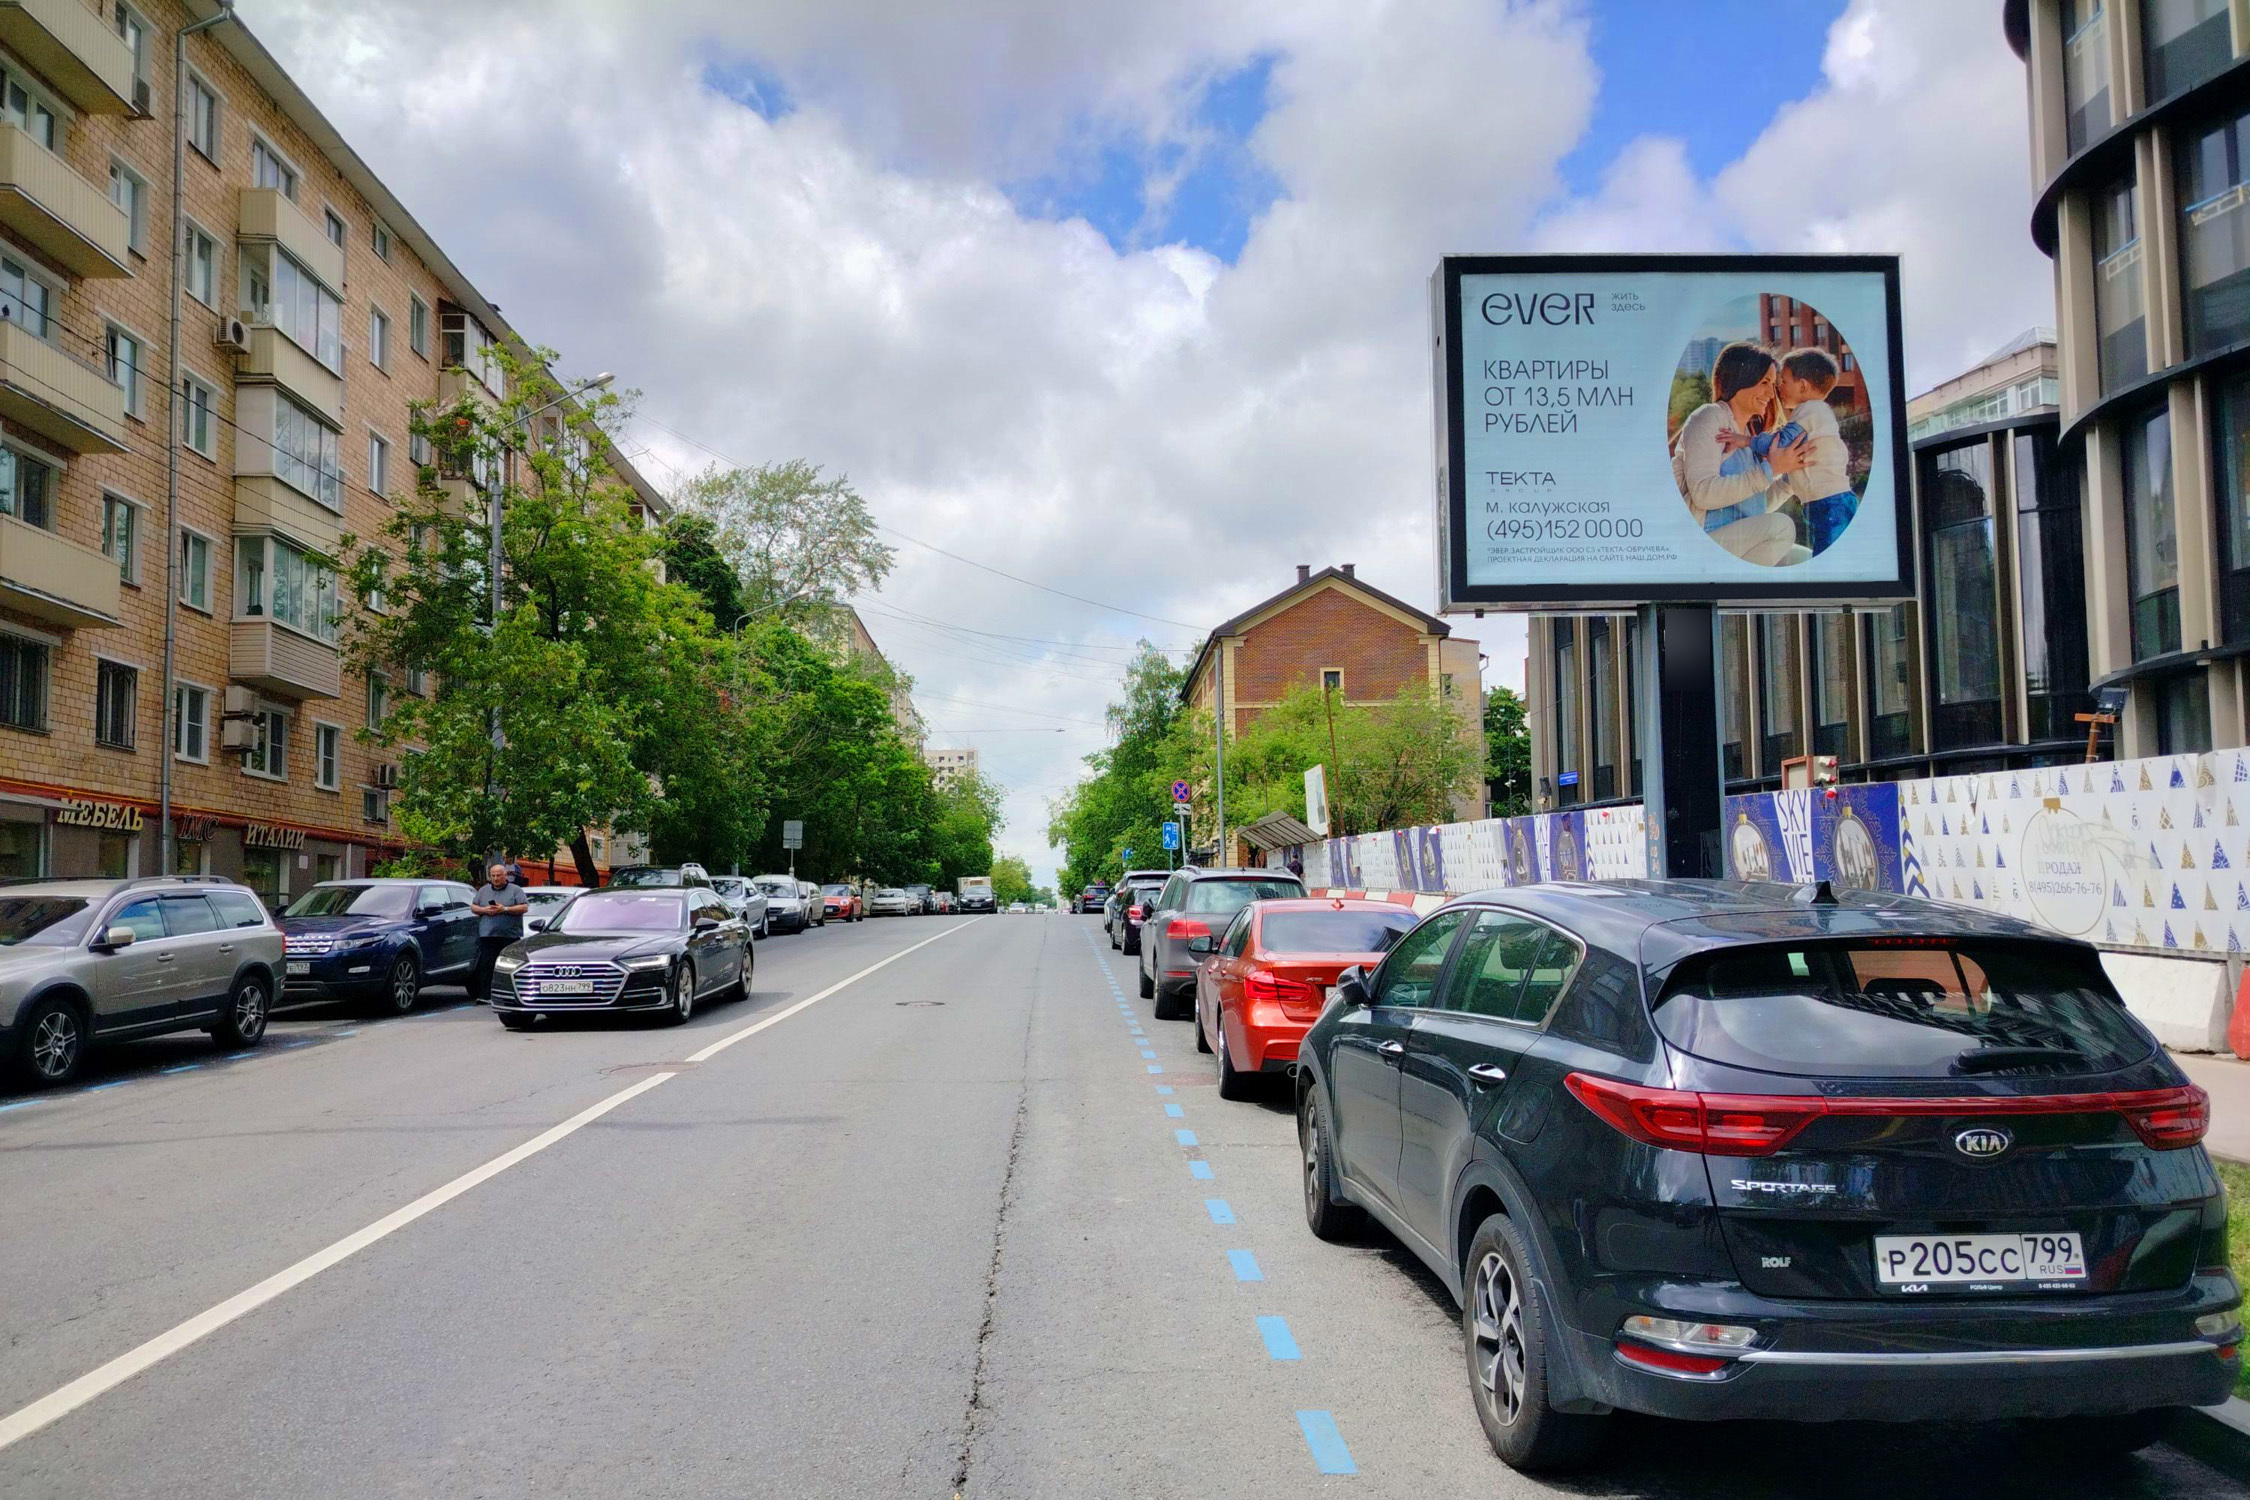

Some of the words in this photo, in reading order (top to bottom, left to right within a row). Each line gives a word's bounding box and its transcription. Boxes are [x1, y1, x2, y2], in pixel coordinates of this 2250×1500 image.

[1484, 359, 1609, 380] КВАРТИРЫ
[1484, 386, 1516, 407] ОТ
[1524, 386, 1570, 408] 13,5
[1577, 386, 1634, 407] МЛН
[1485, 409, 1577, 433] РУБЛЕЙ
[1485, 471, 1556, 486] ТЕКТА
[1509, 501, 1610, 517] калужская
[1533, 555, 1585, 563] ДЕКЛАРАЦИЯ
[57, 798, 144, 831] МЕБЕЛЬ
[1777, 789, 1807, 832] SKY
[245, 823, 307, 850] ИТАЛИИ
[2029, 882, 2102, 896] 8(495)266-76-76
[1965, 1135, 2001, 1151] KIA
[1731, 1179, 1837, 1194] SPORTAGE
[2023, 1237, 2073, 1263] 799
[1761, 1257, 1791, 1268] ROLF
[2039, 1265, 2064, 1275] RUS
